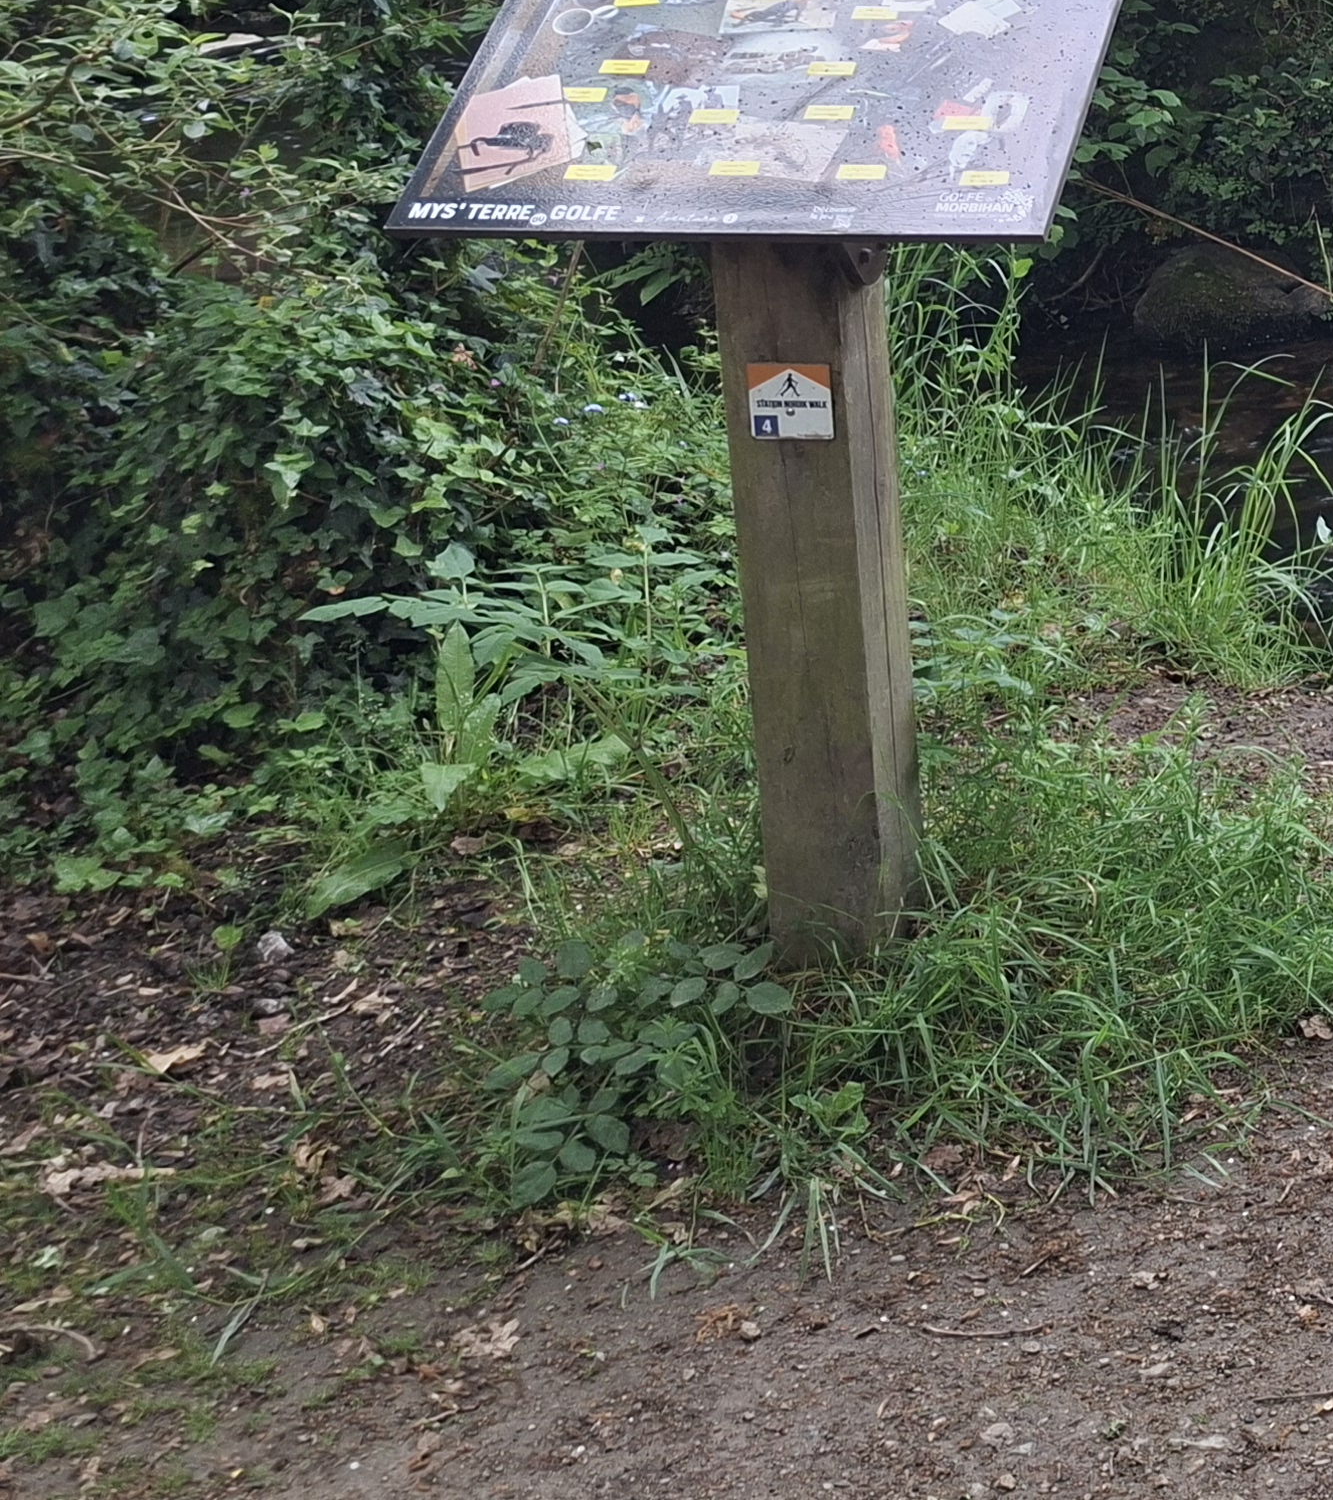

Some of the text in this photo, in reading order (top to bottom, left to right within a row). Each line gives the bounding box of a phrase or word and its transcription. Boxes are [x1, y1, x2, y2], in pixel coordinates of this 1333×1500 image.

[940, 192, 985, 202] GOLFE
[550, 204, 622, 221] GOLFE
[935, 202, 1014, 213] MORBIHAN
[807, 401, 828, 410] WALK
[761, 419, 773, 434] 4
